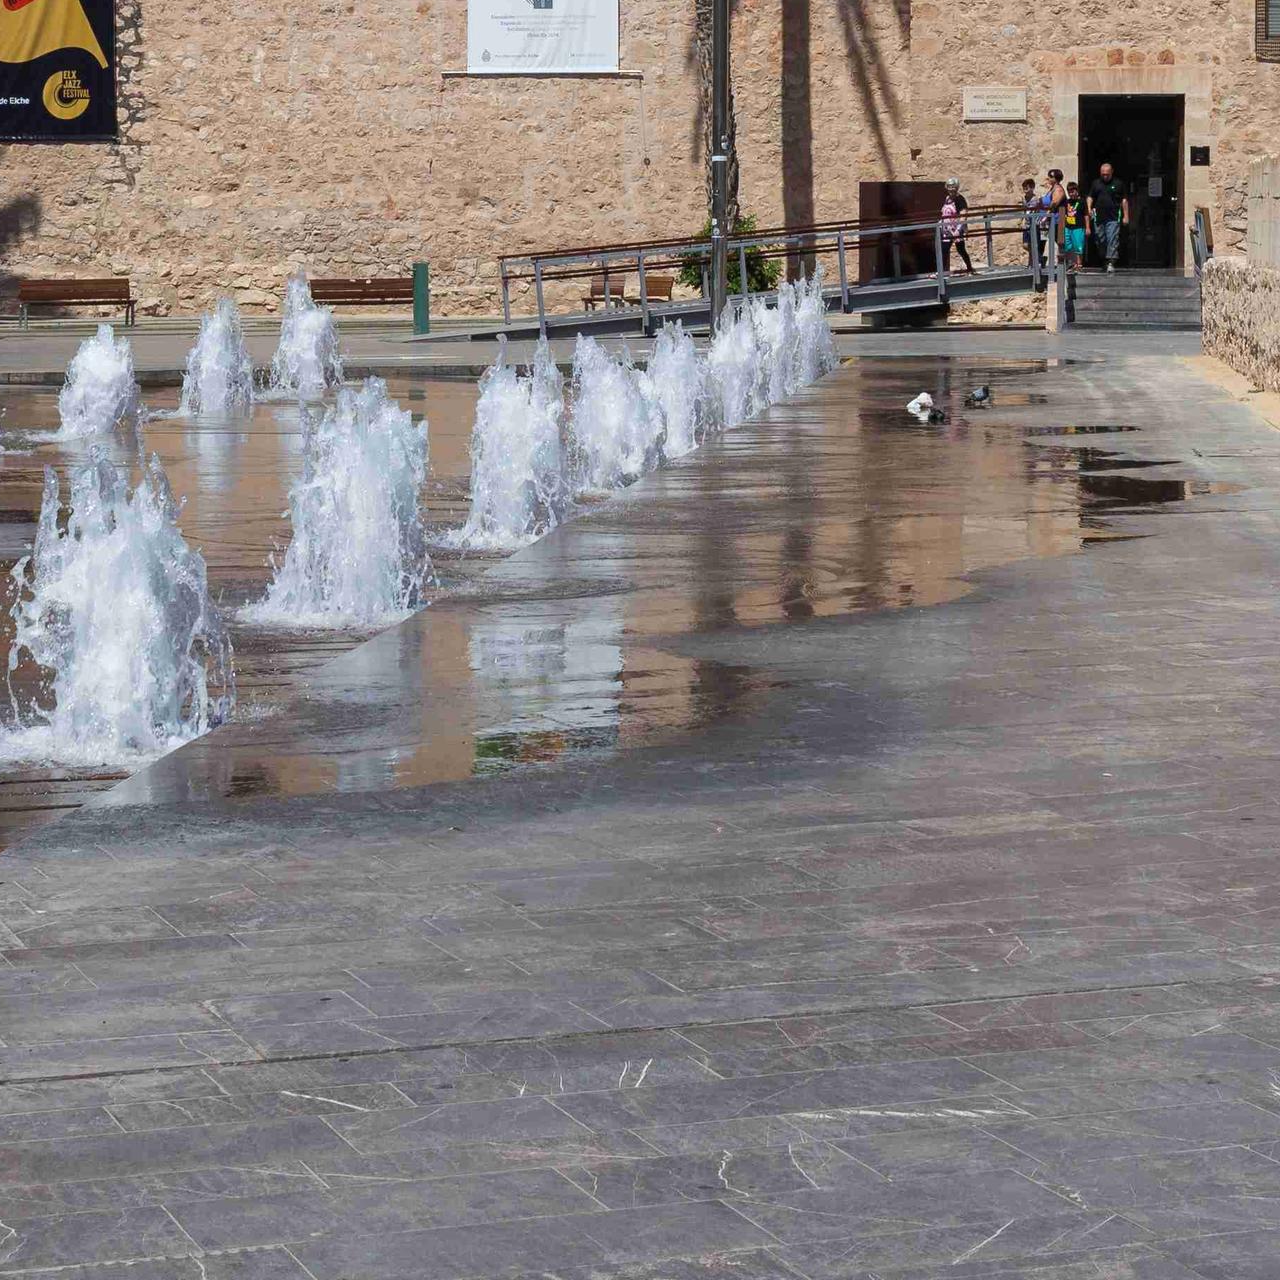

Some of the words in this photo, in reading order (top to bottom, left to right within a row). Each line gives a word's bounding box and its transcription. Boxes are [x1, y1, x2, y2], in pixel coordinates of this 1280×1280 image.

[63, 70, 77, 80] ELX
[62, 79, 82, 89] JAZZ
[62, 88, 90, 98] FESTIVAL
[0, 97, 8, 105] de
[9, 97, 30, 105] Elche
